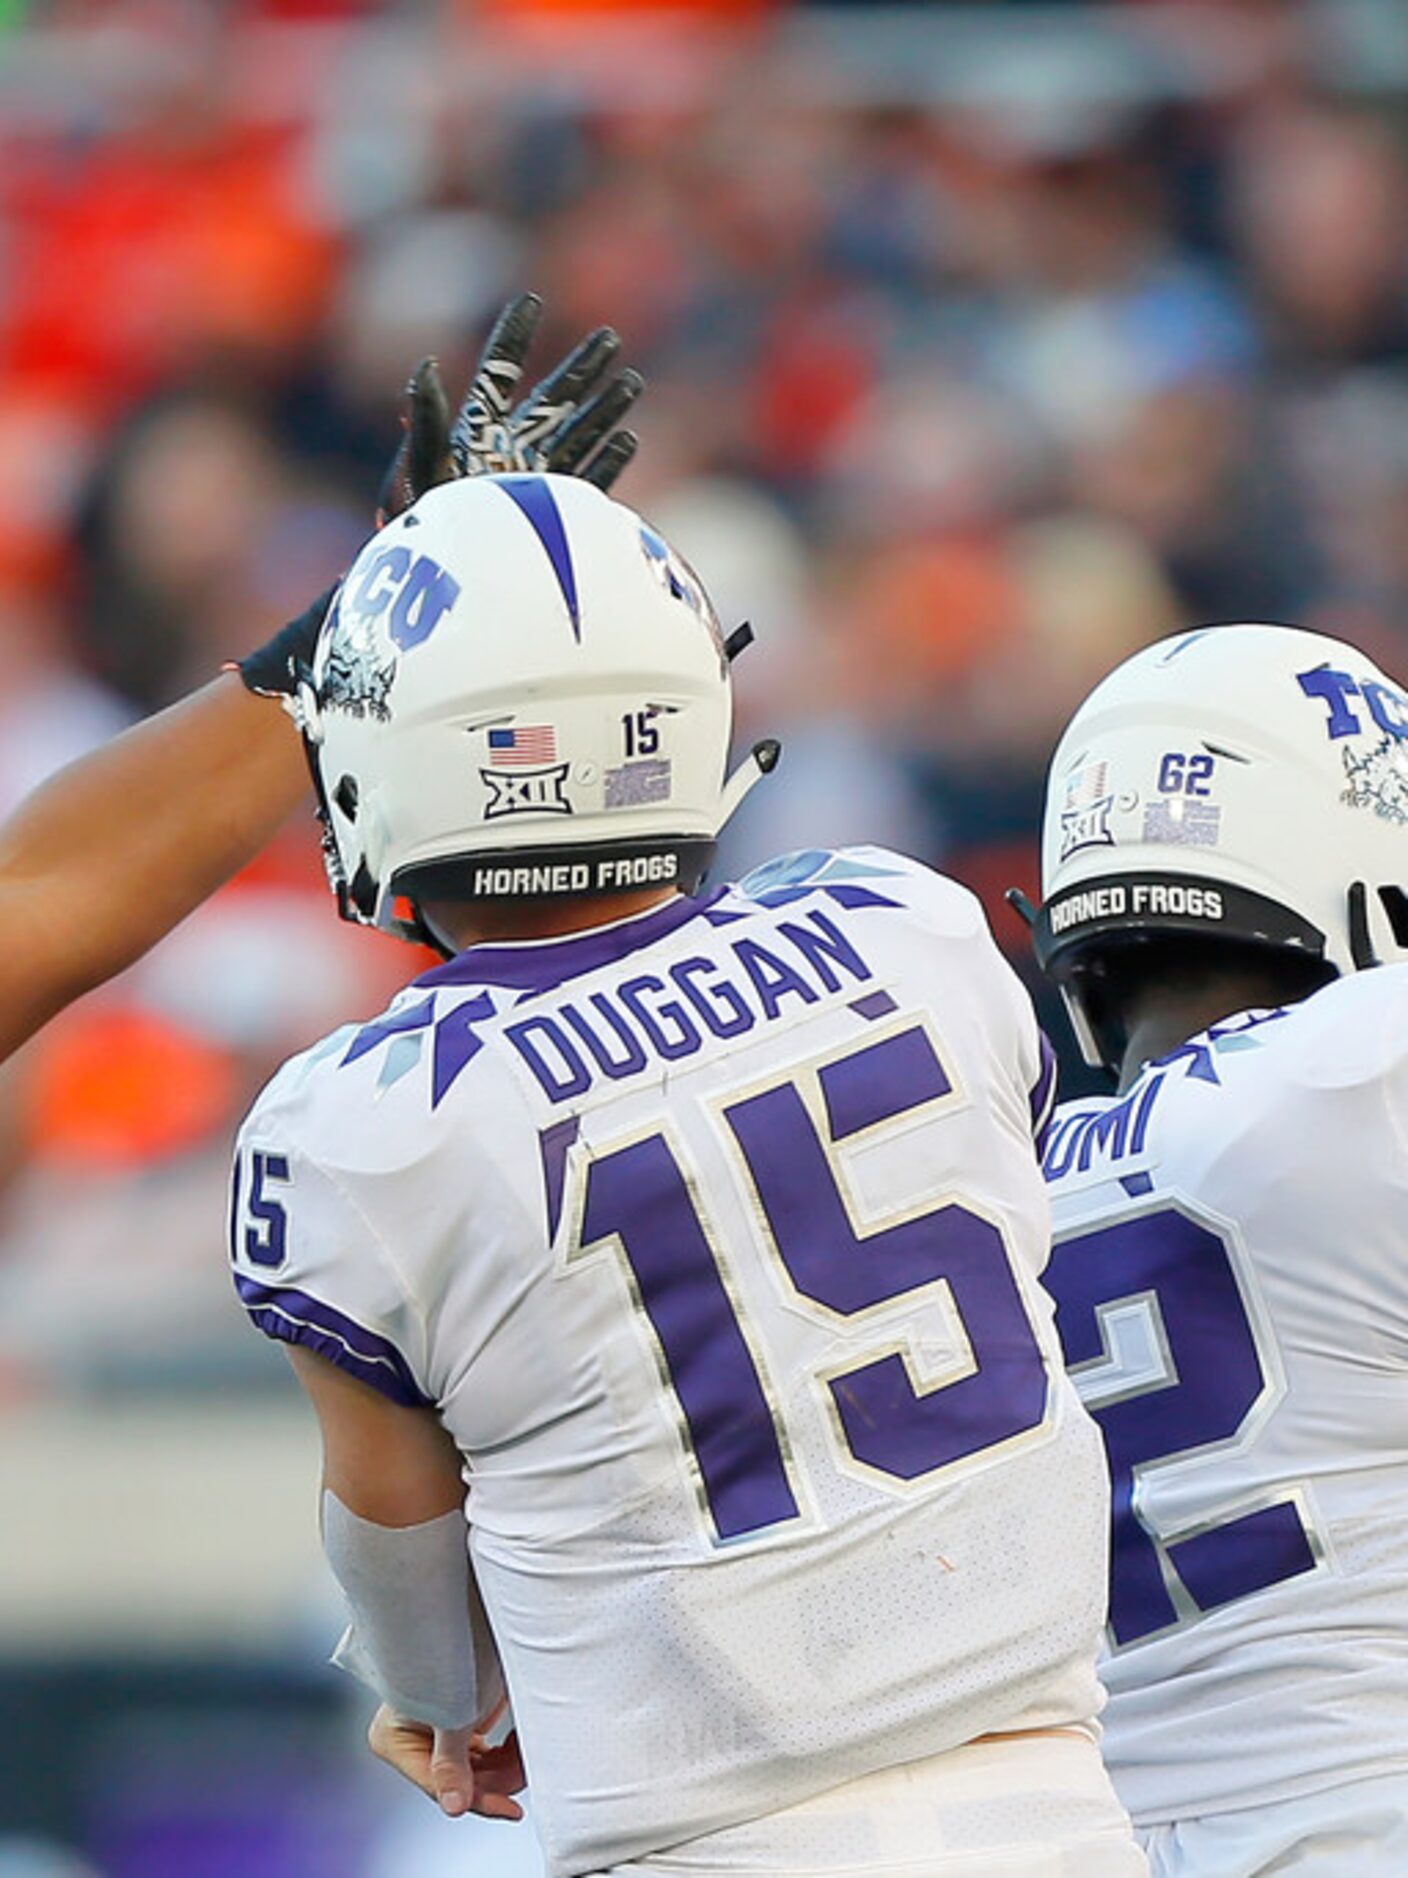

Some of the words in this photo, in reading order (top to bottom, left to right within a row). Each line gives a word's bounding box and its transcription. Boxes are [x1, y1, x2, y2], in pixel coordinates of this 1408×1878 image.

[621, 711, 659, 757] 15
[479, 763, 573, 820] XII
[1157, 753, 1214, 796] 62
[474, 864, 590, 895] HORNED
[597, 854, 678, 889] FROGS
[1049, 887, 1126, 936] HORNED
[1132, 885, 1223, 920] FROGS
[504, 909, 873, 1104] DUGGAN
[1042, 1072, 1167, 1183] OMI
[230, 1148, 291, 1270] 15
[556, 1012, 1058, 1550] 15
